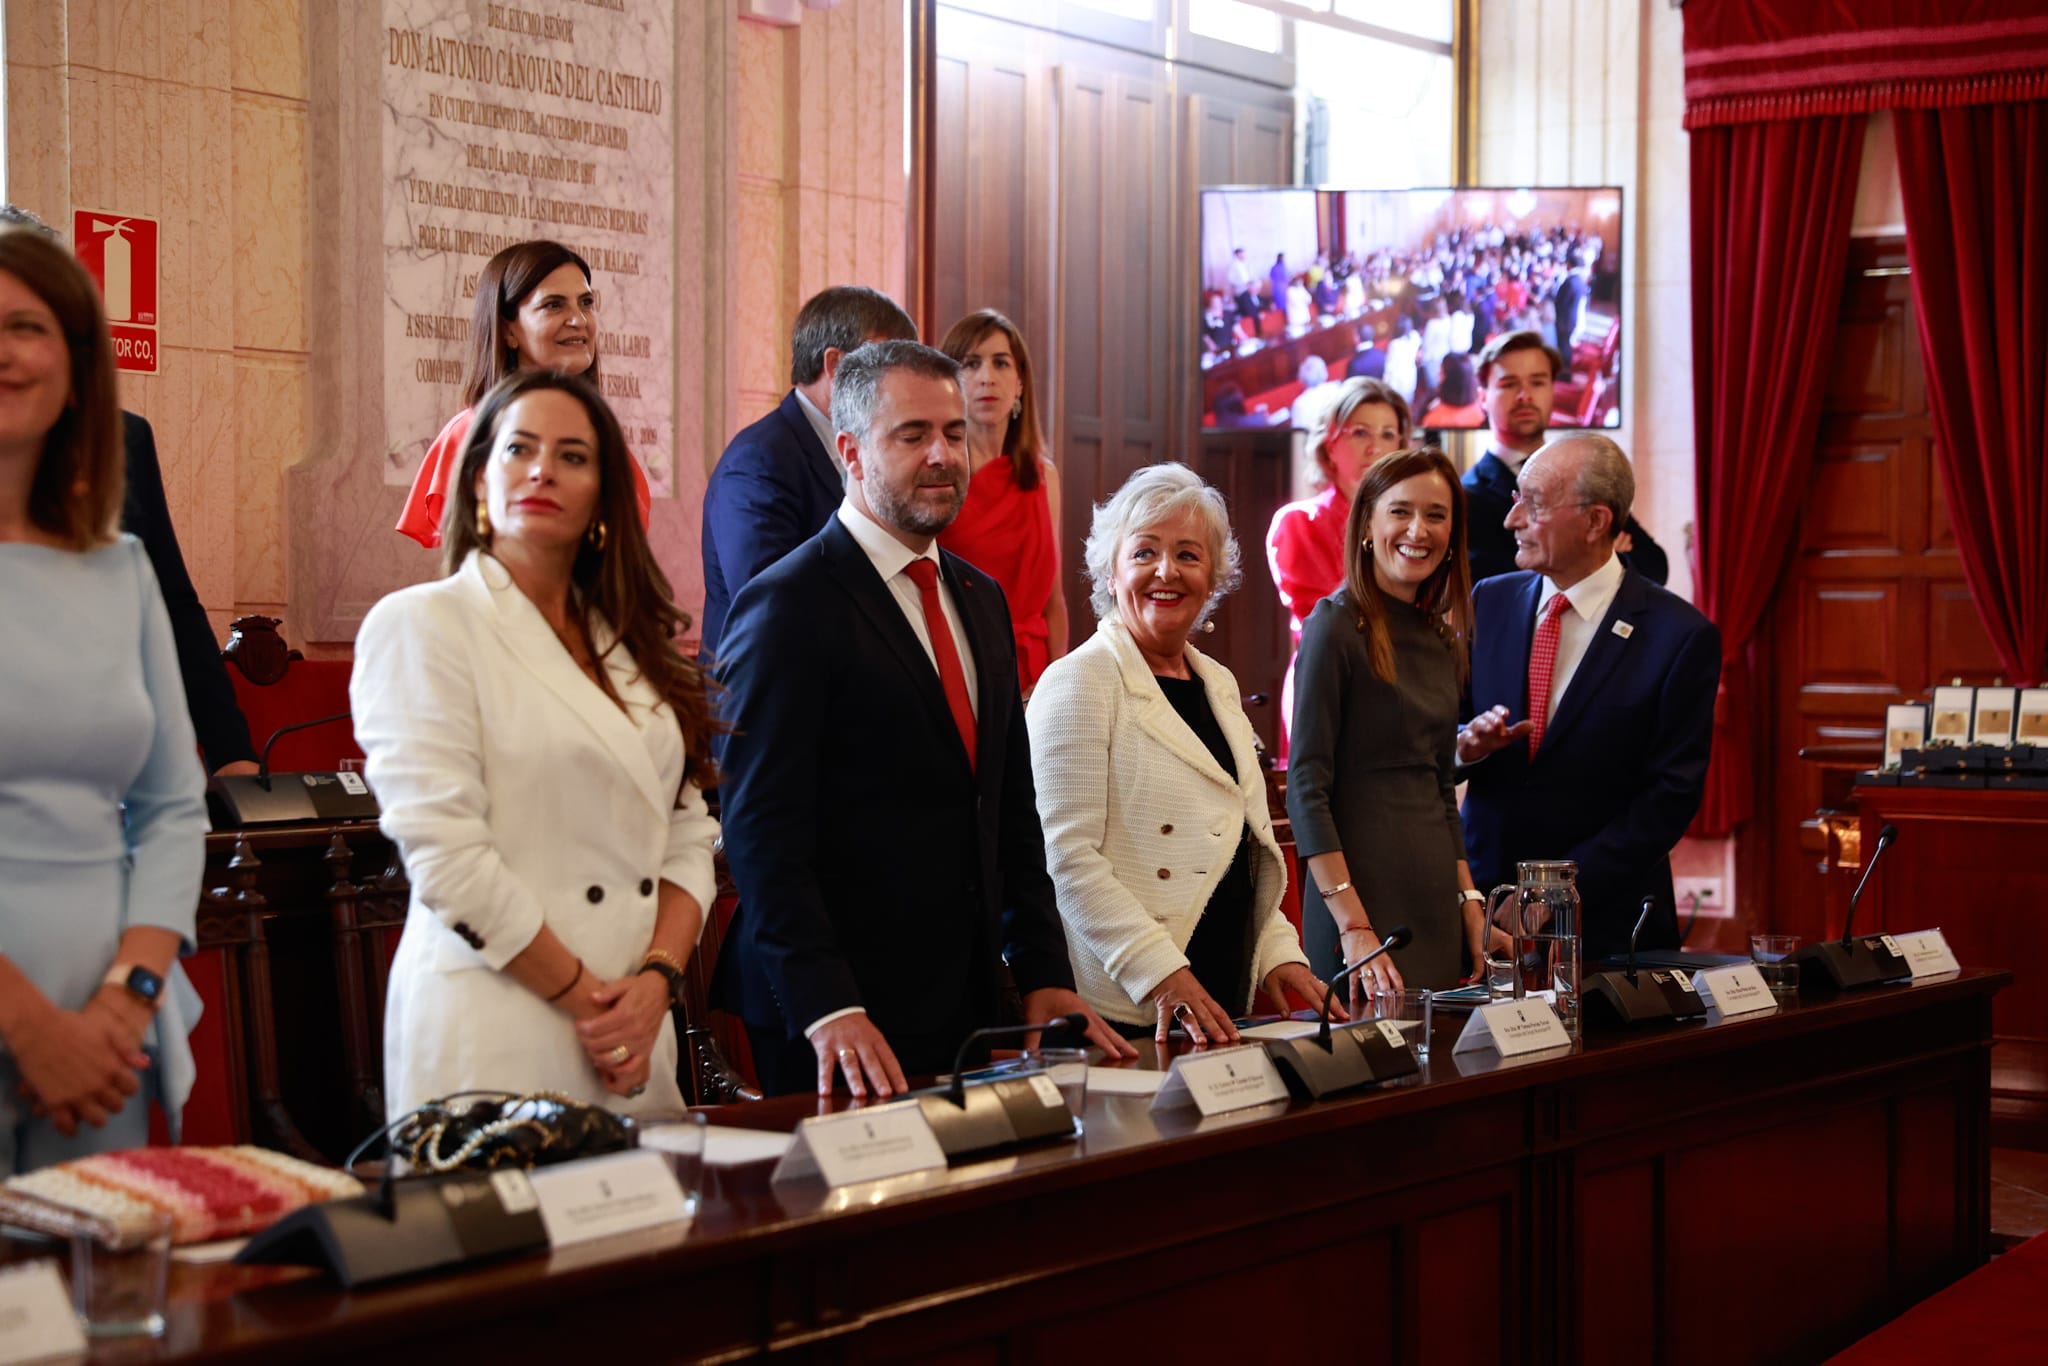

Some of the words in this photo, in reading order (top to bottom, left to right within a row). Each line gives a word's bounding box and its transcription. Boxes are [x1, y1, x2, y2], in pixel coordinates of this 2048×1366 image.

[544, 13, 574, 43] SEÑOR
[390, 27, 421, 70] DON
[425, 34, 493, 84] ANTONIO
[496, 43, 563, 97] CÁNOVAS
[565, 63, 594, 102] DEL
[596, 70, 662, 116] CASTILLO
[429, 94, 444, 119] EN
[445, 96, 518, 132] CUMPLIMIENTO
[539, 112, 582, 143] ACUERDO
[583, 121, 628, 151] PLENARIO
[467, 143, 486, 169] DEL
[531, 154, 565, 182] AGOSTO
[566, 160, 579, 183] DE
[409, 179, 416, 203] Y
[418, 180, 432, 205] EN
[434, 183, 519, 218] AGRADECIMIENTO
[520, 194, 527, 219] A
[528, 196, 546, 222] LAS
[547, 199, 608, 229] IMPORTANTES
[609, 207, 648, 234] MEJORAS
[418, 224, 438, 250] POR
[439, 223, 453, 252] ÉL
[603, 244, 639, 276] MÁLAGA
[405, 312, 414, 338] A
[415, 313, 433, 338] SUS
[622, 334, 650, 358] LABOR
[415, 358, 443, 383] COMO
